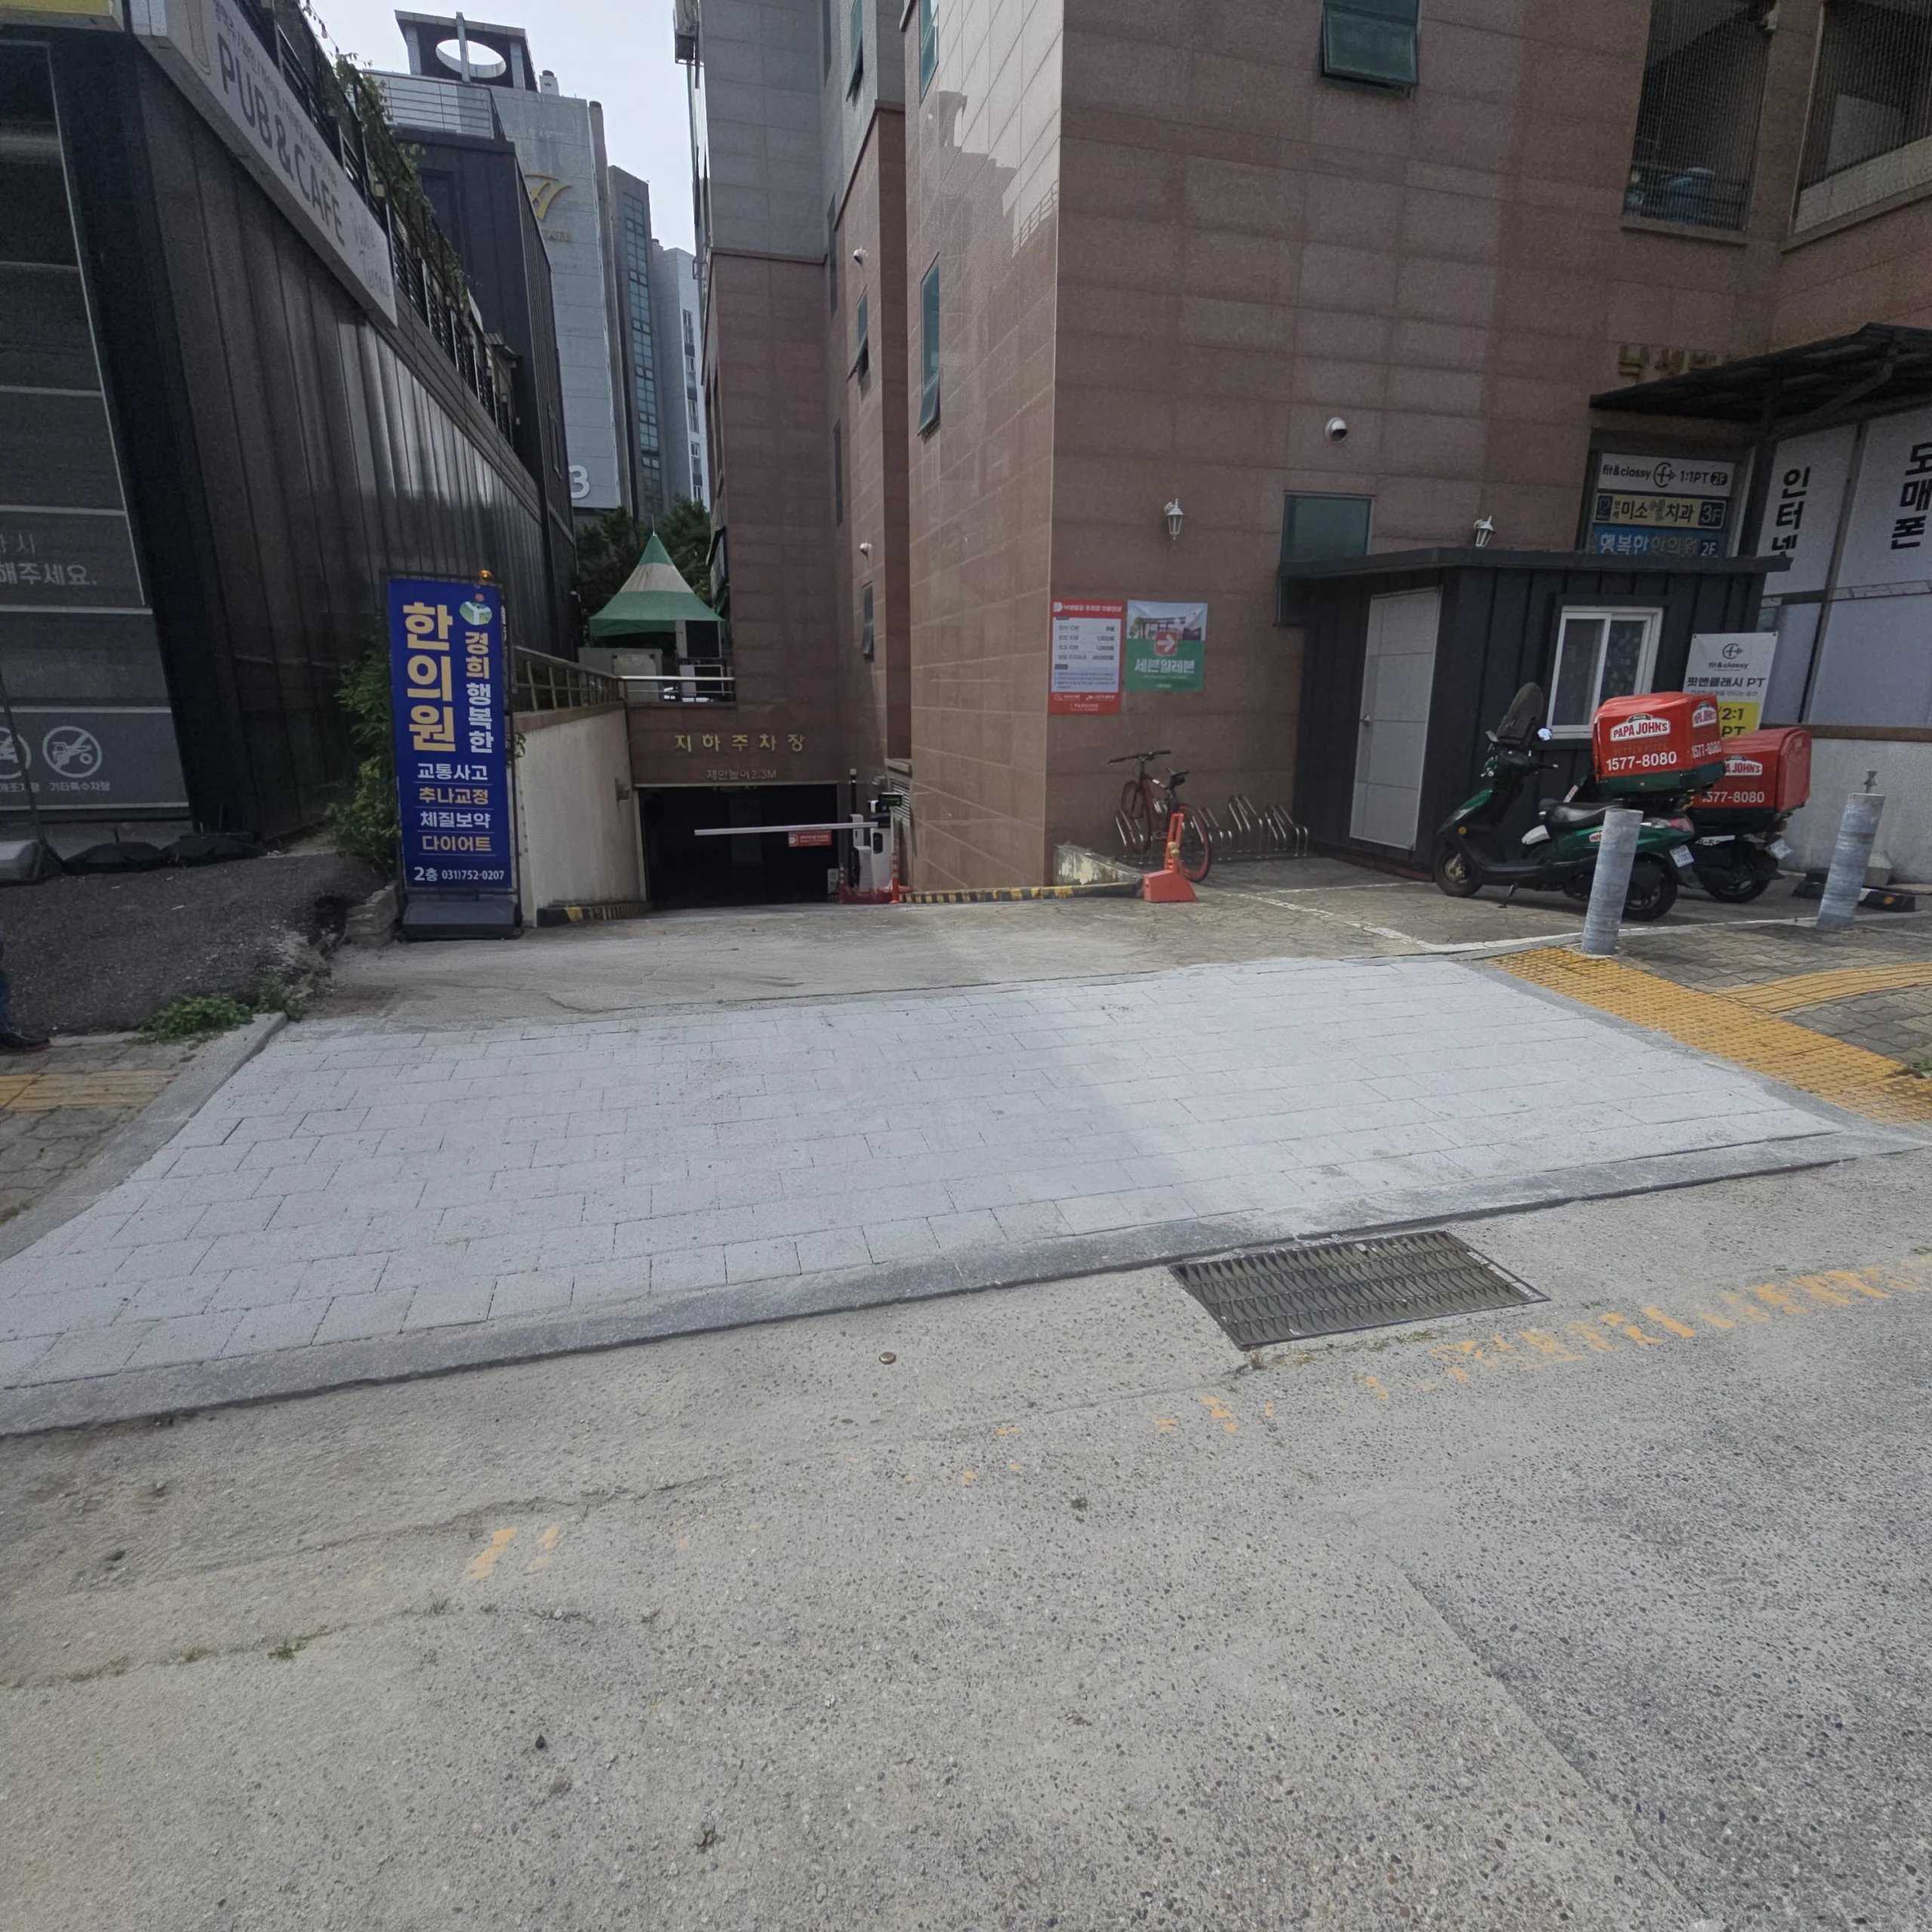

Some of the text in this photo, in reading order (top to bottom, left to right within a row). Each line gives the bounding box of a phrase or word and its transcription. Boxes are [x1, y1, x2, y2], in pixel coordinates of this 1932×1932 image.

[1601, 464, 1651, 480] fit&classy
[1712, 474, 1727, 485] 2F
[1700, 503, 1721, 524] 3F
[1771, 466, 1810, 558] 인터넷
[1700, 541, 1717, 557] 2F
[1134, 658, 1195, 674] 세븐일레븐
[402, 601, 456, 752] 한의원
[1687, 677, 1766, 688] 핏앤클래시 PT
[1613, 720, 1668, 738] PAPA JOHN'S
[1721, 725, 1746, 737] PT
[675, 734, 805, 752] 지하주차장
[1606, 752, 1677, 771] 1577-8080
[417, 763, 488, 781] 교통사고
[48, 780, 111, 792] 기타특수차량
[418, 787, 489, 805] 추나교정
[1702, 791, 1764, 803] 577-8080
[420, 811, 491, 829] 체질보약
[422, 834, 492, 852] 다이어트
[414, 866, 505, 882] 2층 031)752-0207
